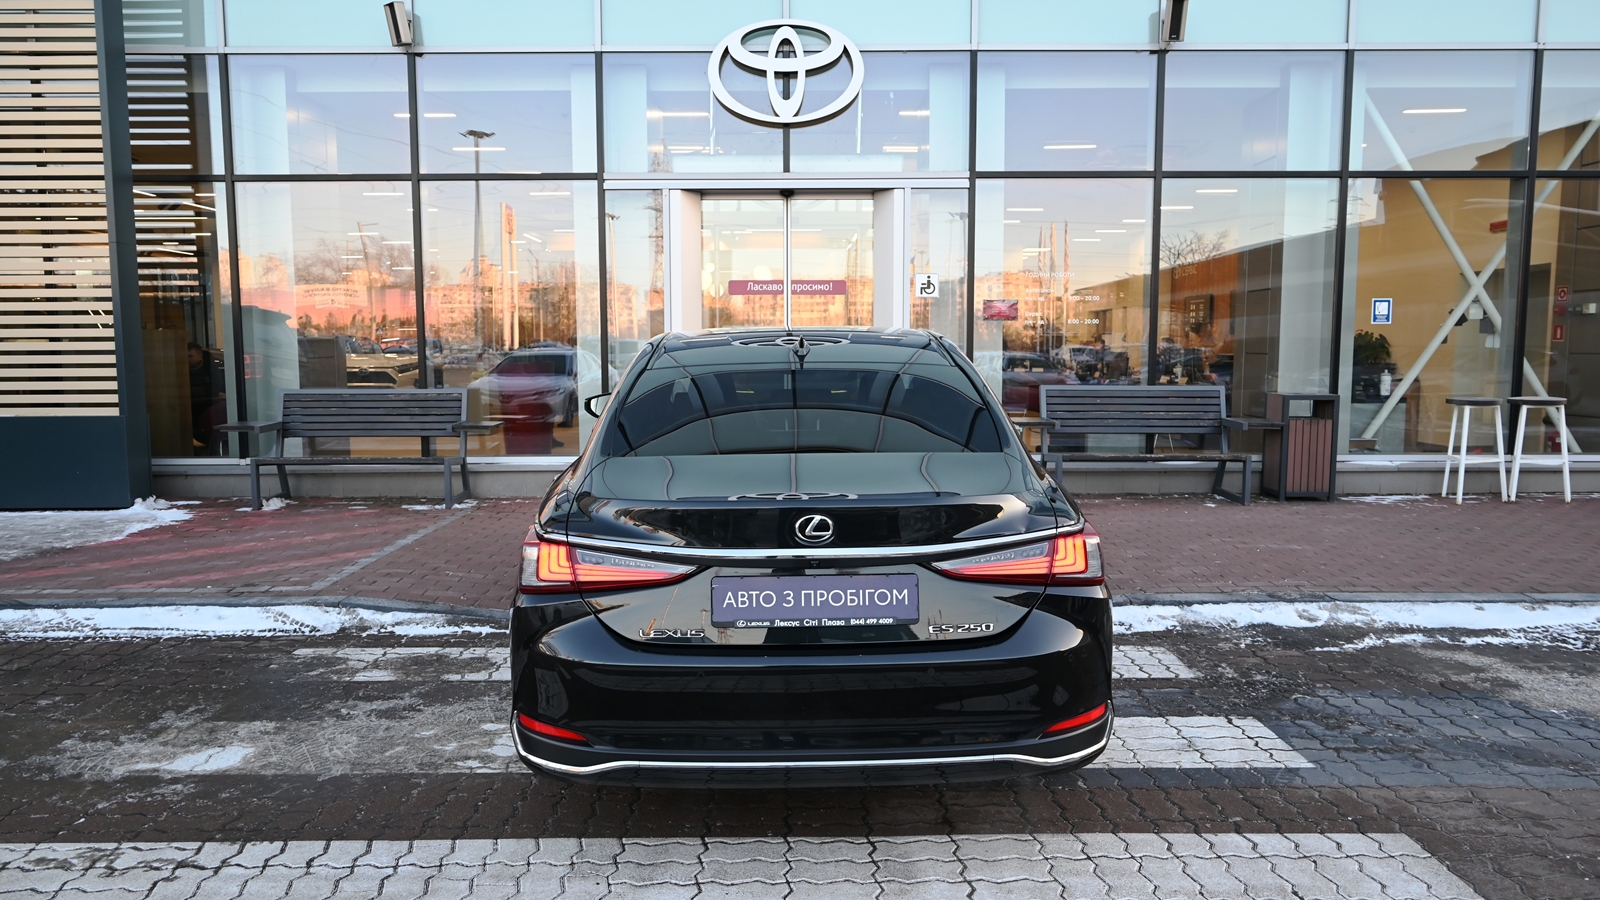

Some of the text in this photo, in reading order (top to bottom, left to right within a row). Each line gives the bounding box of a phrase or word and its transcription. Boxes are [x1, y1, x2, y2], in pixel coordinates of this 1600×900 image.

[747, 282, 833, 292] Ласкаво просимо!
[723, 590, 777, 608] АВТО
[801, 588, 909, 607] ПРОБІГОМ
[774, 619, 800, 627] Лексус
[803, 618, 818, 626] Сіті
[821, 618, 846, 626] Плаза
[850, 617, 865, 625] (044)
[639, 628, 706, 638] LEXUS
[928, 622, 994, 634] ES 250
